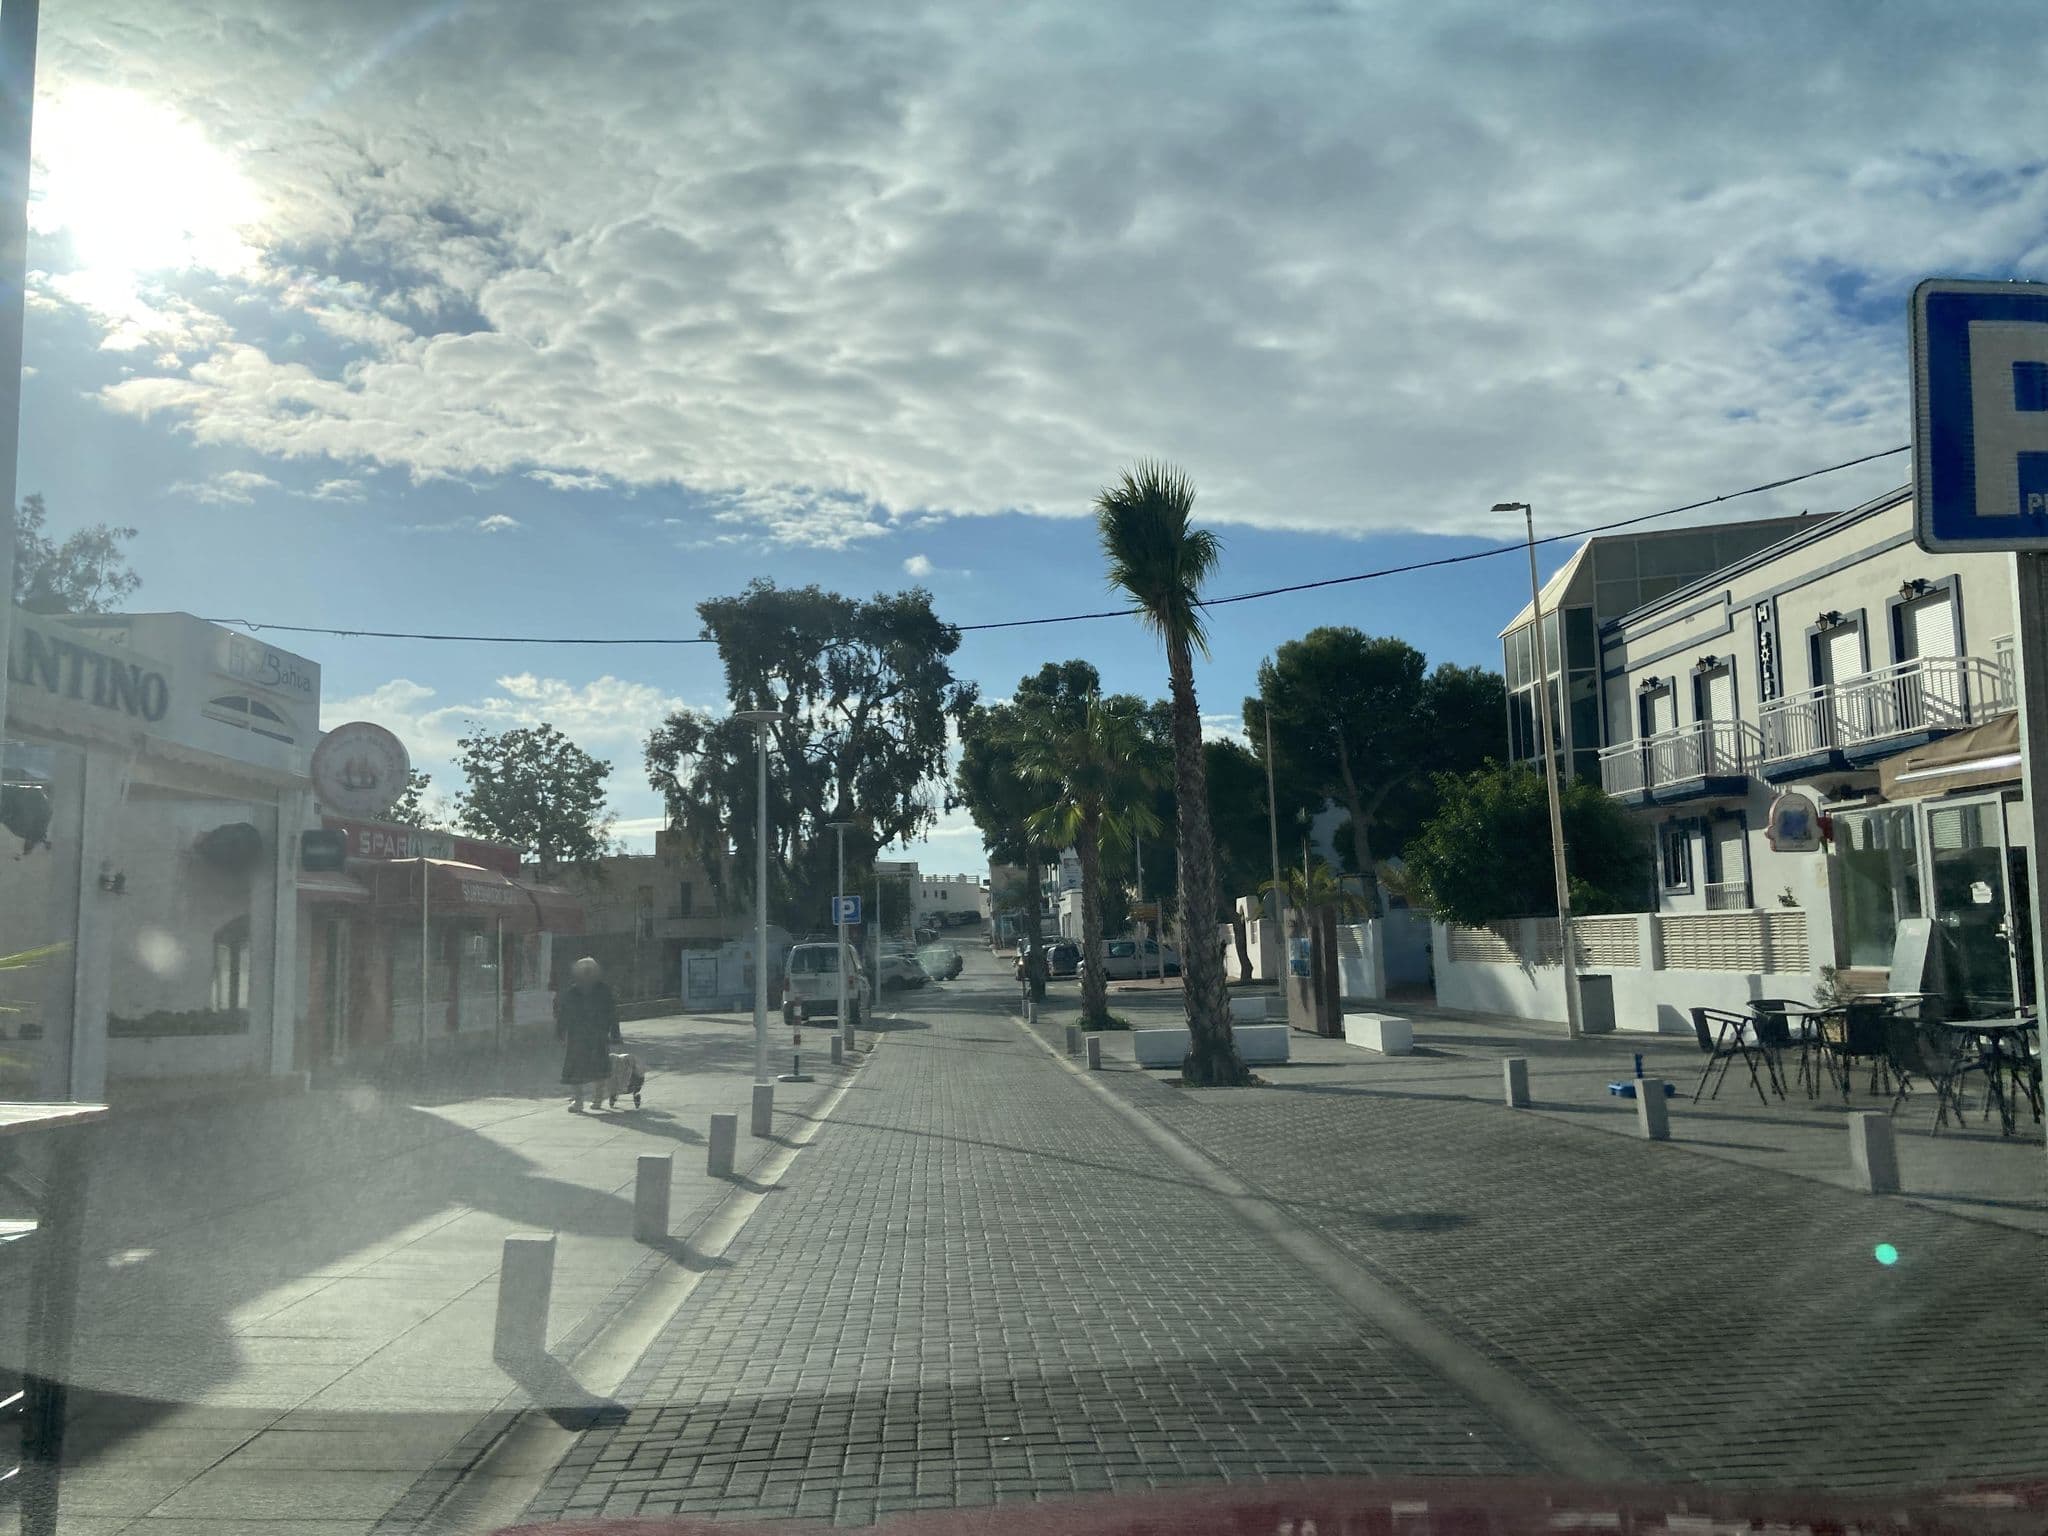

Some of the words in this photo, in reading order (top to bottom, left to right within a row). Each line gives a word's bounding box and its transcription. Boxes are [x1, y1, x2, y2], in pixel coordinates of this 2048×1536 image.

[2028, 493, 2048, 515] P
[359, 830, 408, 857] SPAR
[840, 900, 856, 921] P
